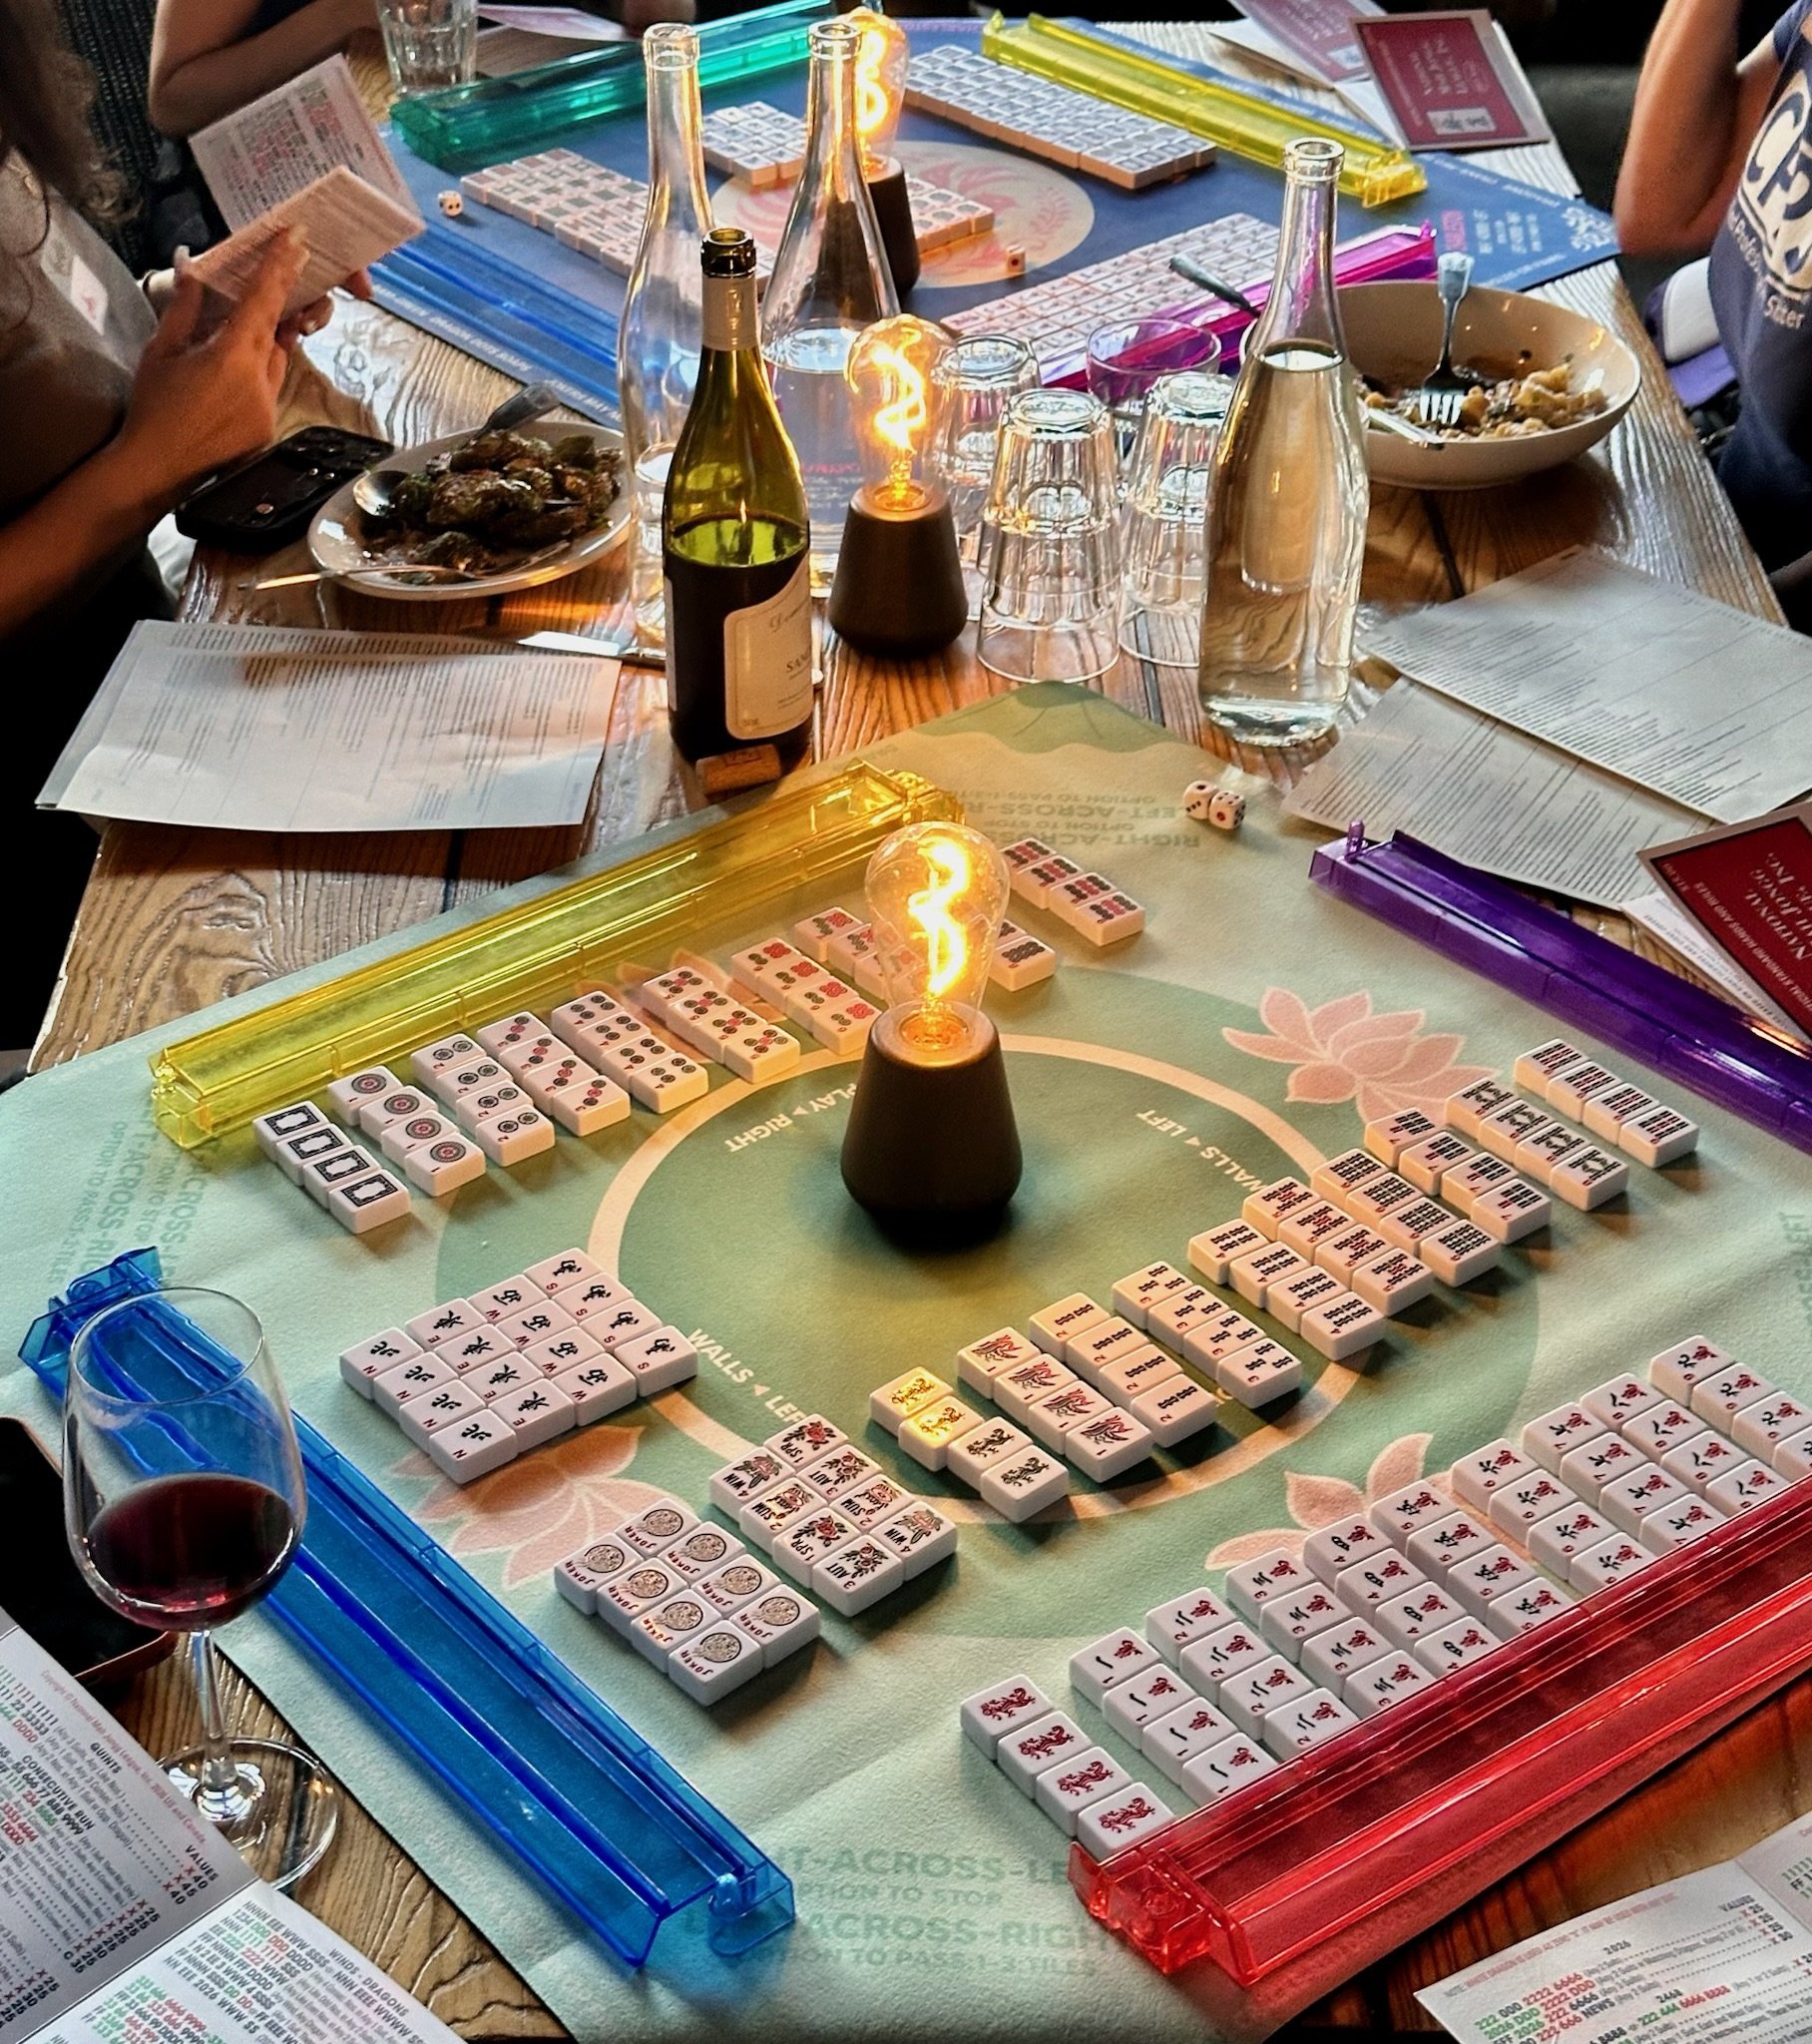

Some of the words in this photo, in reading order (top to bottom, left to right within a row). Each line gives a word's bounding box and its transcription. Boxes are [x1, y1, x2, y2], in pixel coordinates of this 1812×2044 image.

[967, 801, 1184, 819] EFT-ACROSS-R
[1036, 820, 1058, 830] TO
[1065, 821, 1135, 832] OPTION
[809, 1083, 857, 1113] PLAY
[724, 1113, 793, 1152] RIGHT
[1136, 1110, 1186, 1137] LEFT
[1200, 1146, 1268, 1192] WALLS
[88, 1169, 109, 1188] TO
[149, 1189, 169, 1207] TO
[134, 1208, 161, 1243] STOP
[546, 1281, 558, 1291] S
[486, 1308, 501, 1320] W
[576, 1307, 588, 1317] S
[428, 1335, 439, 1344] E
[515, 1334, 530, 1346] W
[604, 1334, 616, 1344] S
[363, 1364, 377, 1374] N
[458, 1361, 469, 1370] E
[542, 1361, 557, 1373] W
[638, 1361, 650, 1370] S
[687, 1328, 754, 1383] WALLS
[764, 1395, 807, 1423] LEF
[396, 1390, 410, 1400] N
[485, 1390, 496, 1399] E
[573, 1389, 588, 1401] W
[423, 1418, 437, 1428] N
[514, 1417, 525, 1426] E
[453, 1449, 467, 1459] N
[780, 1442, 803, 1457] SPR
[723, 1473, 748, 1490] WIN
[808, 1470, 833, 1486] AUT
[826, 1487, 838, 1496] 3
[751, 1502, 776, 1520] SUM
[841, 1498, 865, 1516] SUM
[625, 1526, 657, 1549] JOKER
[884, 1528, 908, 1546] WIN
[790, 1538, 814, 1557] SPR
[668, 1551, 700, 1574] JOKER
[825, 1562, 850, 1579] AUT
[565, 1560, 596, 1585] JOKER
[843, 1580, 856, 1589] 3
[609, 1585, 639, 1610] JOKER
[701, 1582, 733, 1606] JOKER
[644, 1619, 674, 1642] JOKER
[739, 1614, 773, 1638] JOKER
[680, 1650, 713, 1675] JOKER
[24, 1751, 75, 1811] CONSECUTIVE
[76, 1807, 94, 1829] RUN
[11, 1700, 24, 1710] 22
[182, 1880, 200, 1899] 45
[90, 1742, 121, 1774] QUINTS
[185, 1844, 221, 1884] VALUES
[38, 1787, 49, 1798] 77
[62, 1812, 83, 1836] 9999
[146, 1906, 160, 1921] 25
[193, 1873, 211, 1890] 40
[171, 1888, 188, 1905] 40
[798, 1881, 880, 1901] PTION
[887, 1884, 924, 1902] TO
[114, 1928, 128, 1944] 25
[852, 1945, 889, 1966] TO
[71, 1958, 84, 1974] 35
[261, 1963, 287, 1984] WWW
[328, 1948, 359, 1974] WINDS
[361, 1977, 410, 2016] DRAGONS
[12, 1998, 26, 2014] 25
[193, 1979, 219, 1999] 2026
[216, 1998, 244, 2021] WWW
[242, 2021, 258, 2033] SS
[1583, 1998, 1616, 2019] NEWS
